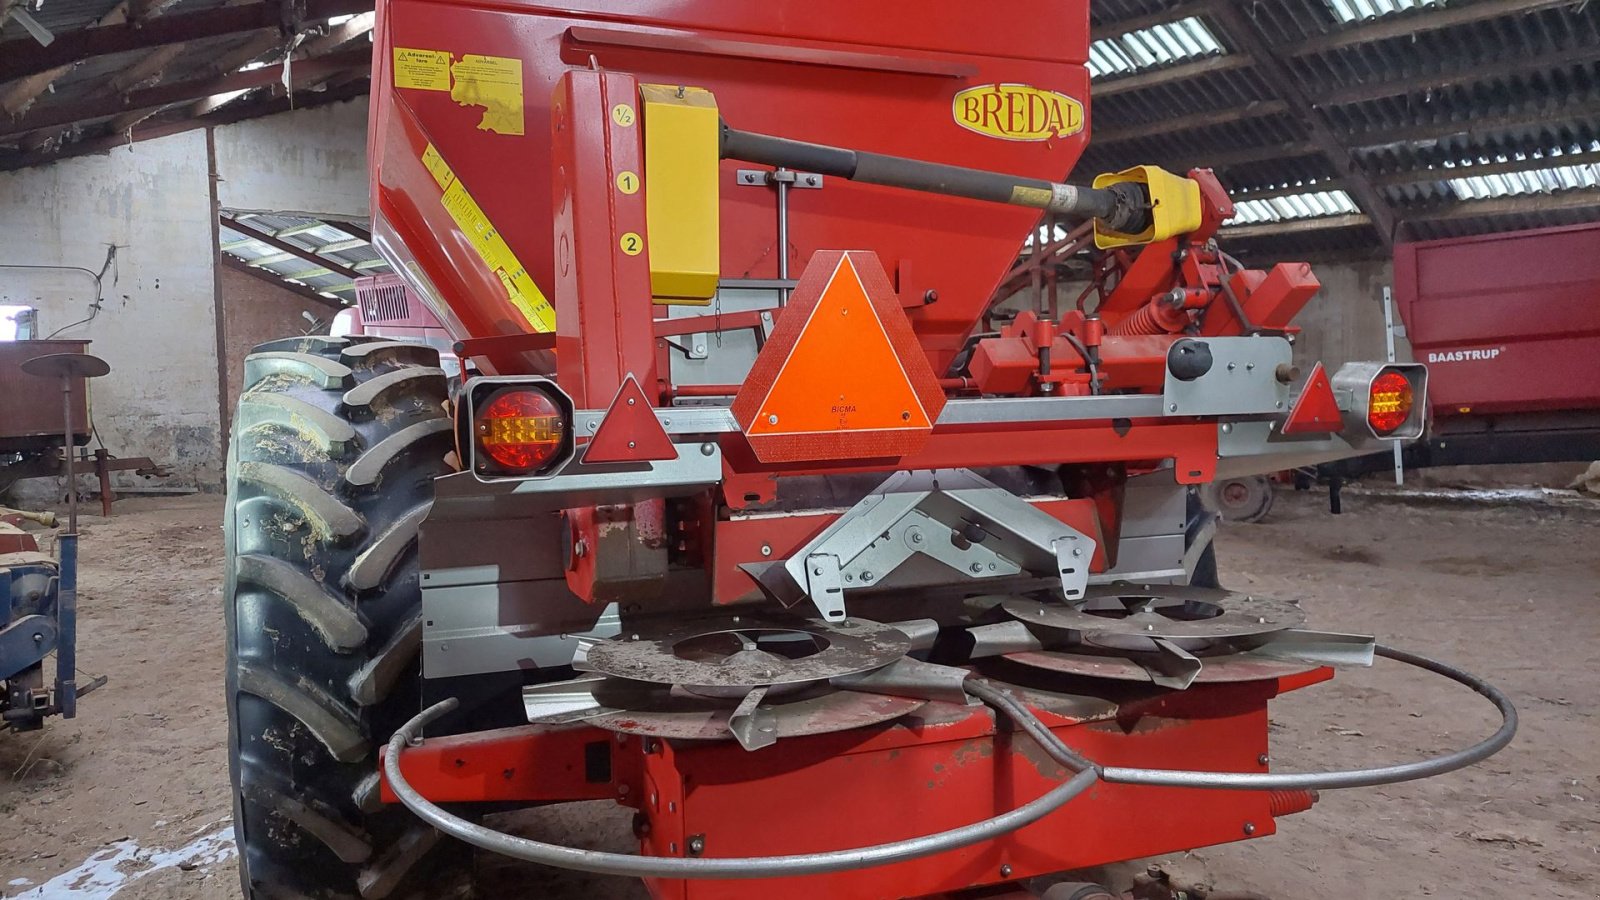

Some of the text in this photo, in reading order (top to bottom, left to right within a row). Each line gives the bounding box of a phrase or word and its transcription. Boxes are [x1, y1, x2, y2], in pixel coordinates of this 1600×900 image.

[963, 92, 1079, 134] BREDAL
[623, 176, 631, 190] 1
[626, 237, 637, 251] 2
[1428, 349, 1499, 363] BAASTRUP
